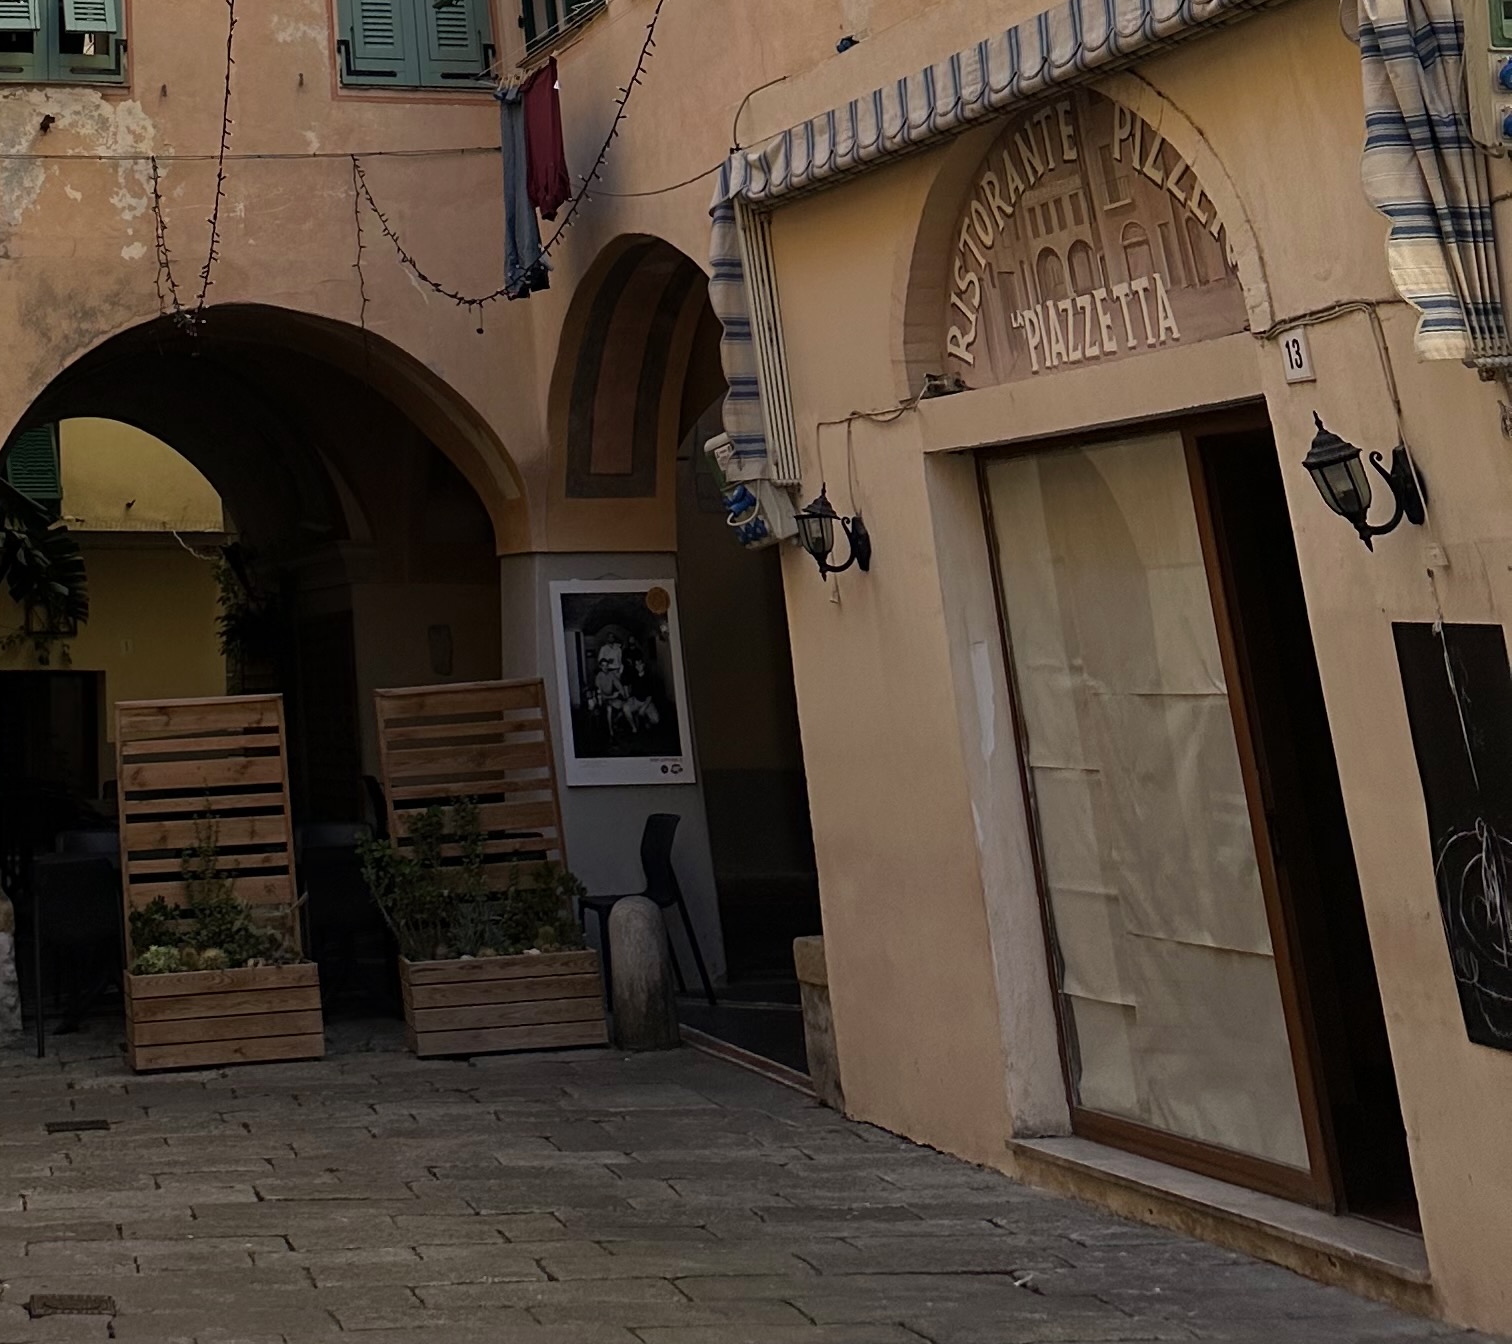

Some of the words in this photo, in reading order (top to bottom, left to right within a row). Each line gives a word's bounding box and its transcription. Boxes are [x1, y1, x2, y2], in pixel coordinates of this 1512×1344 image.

[947, 100, 1078, 367] RISTORANTE
[1011, 309, 1024, 329] LA
[1023, 273, 1180, 374] PIAZZETTA
[1283, 337, 1303, 371] 13
